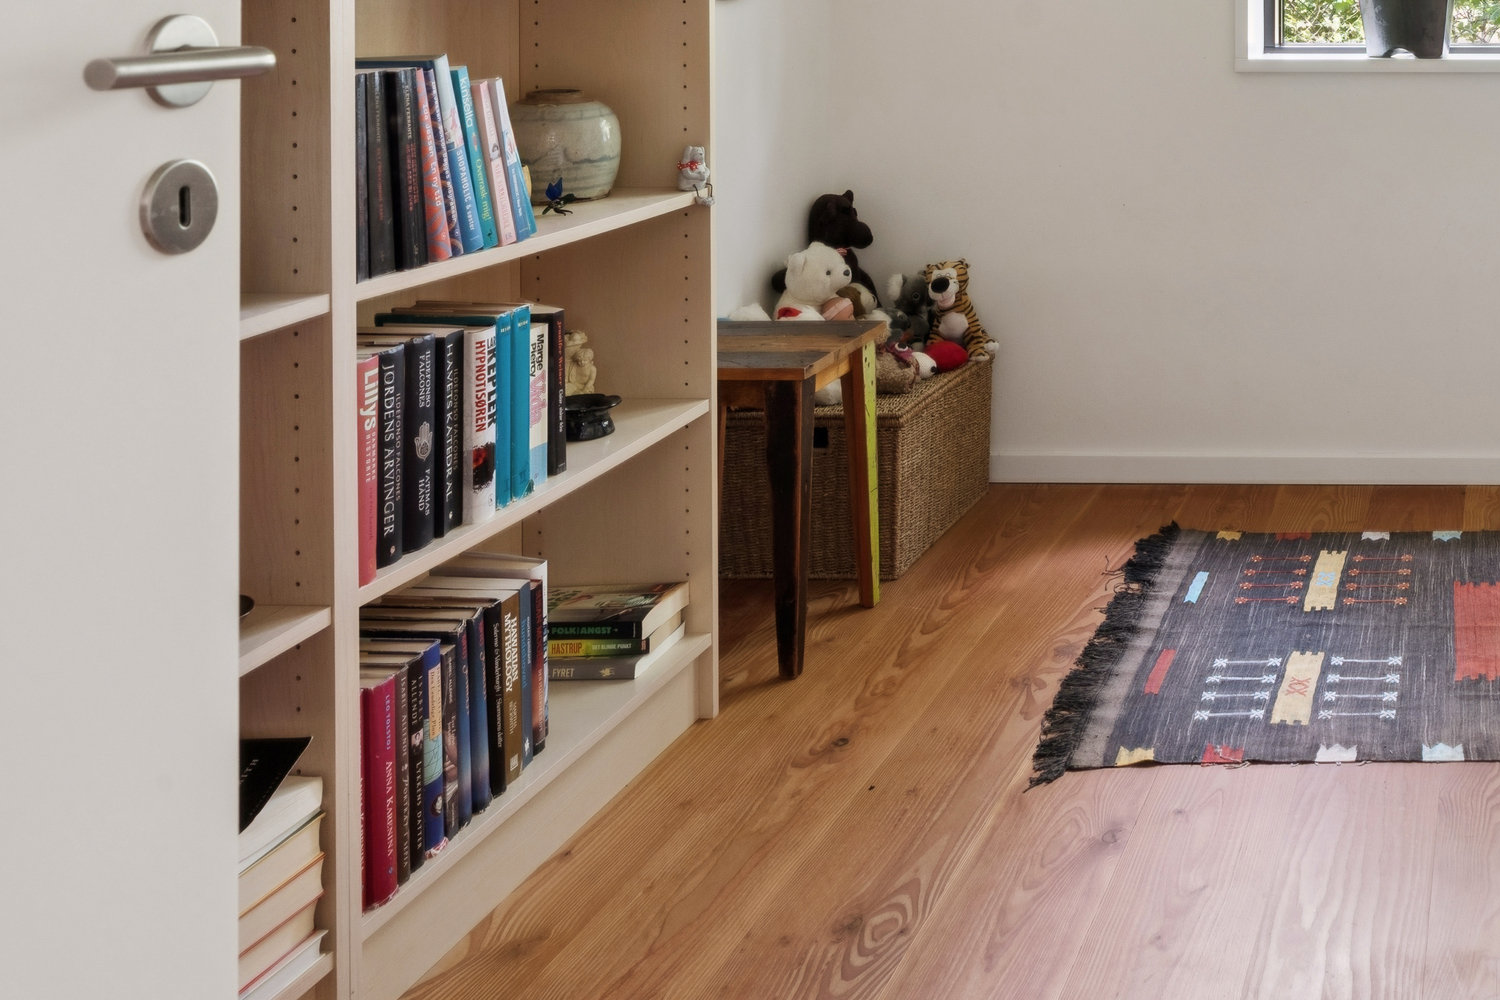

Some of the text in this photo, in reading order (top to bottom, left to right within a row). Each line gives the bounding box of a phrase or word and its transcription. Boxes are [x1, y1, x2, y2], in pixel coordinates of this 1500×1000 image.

[426, 124, 434, 157] Jessen
[460, 76, 491, 221] kinsella Overrask mig!
[456, 150, 472, 202] SHOPAHOLIC
[446, 344, 454, 410] HAVETS
[536, 334, 544, 370] Marge
[360, 367, 378, 431] Lillys
[474, 341, 486, 432] HYPNOTISØREN
[487, 350, 496, 428] KEPLER
[530, 370, 547, 428] Vida
[382, 364, 394, 537] JORDENS ARVINGER
[504, 612, 512, 692] MYTHOLOGY
[551, 642, 582, 654] HASTRUP
[552, 668, 575, 678] FYRET
